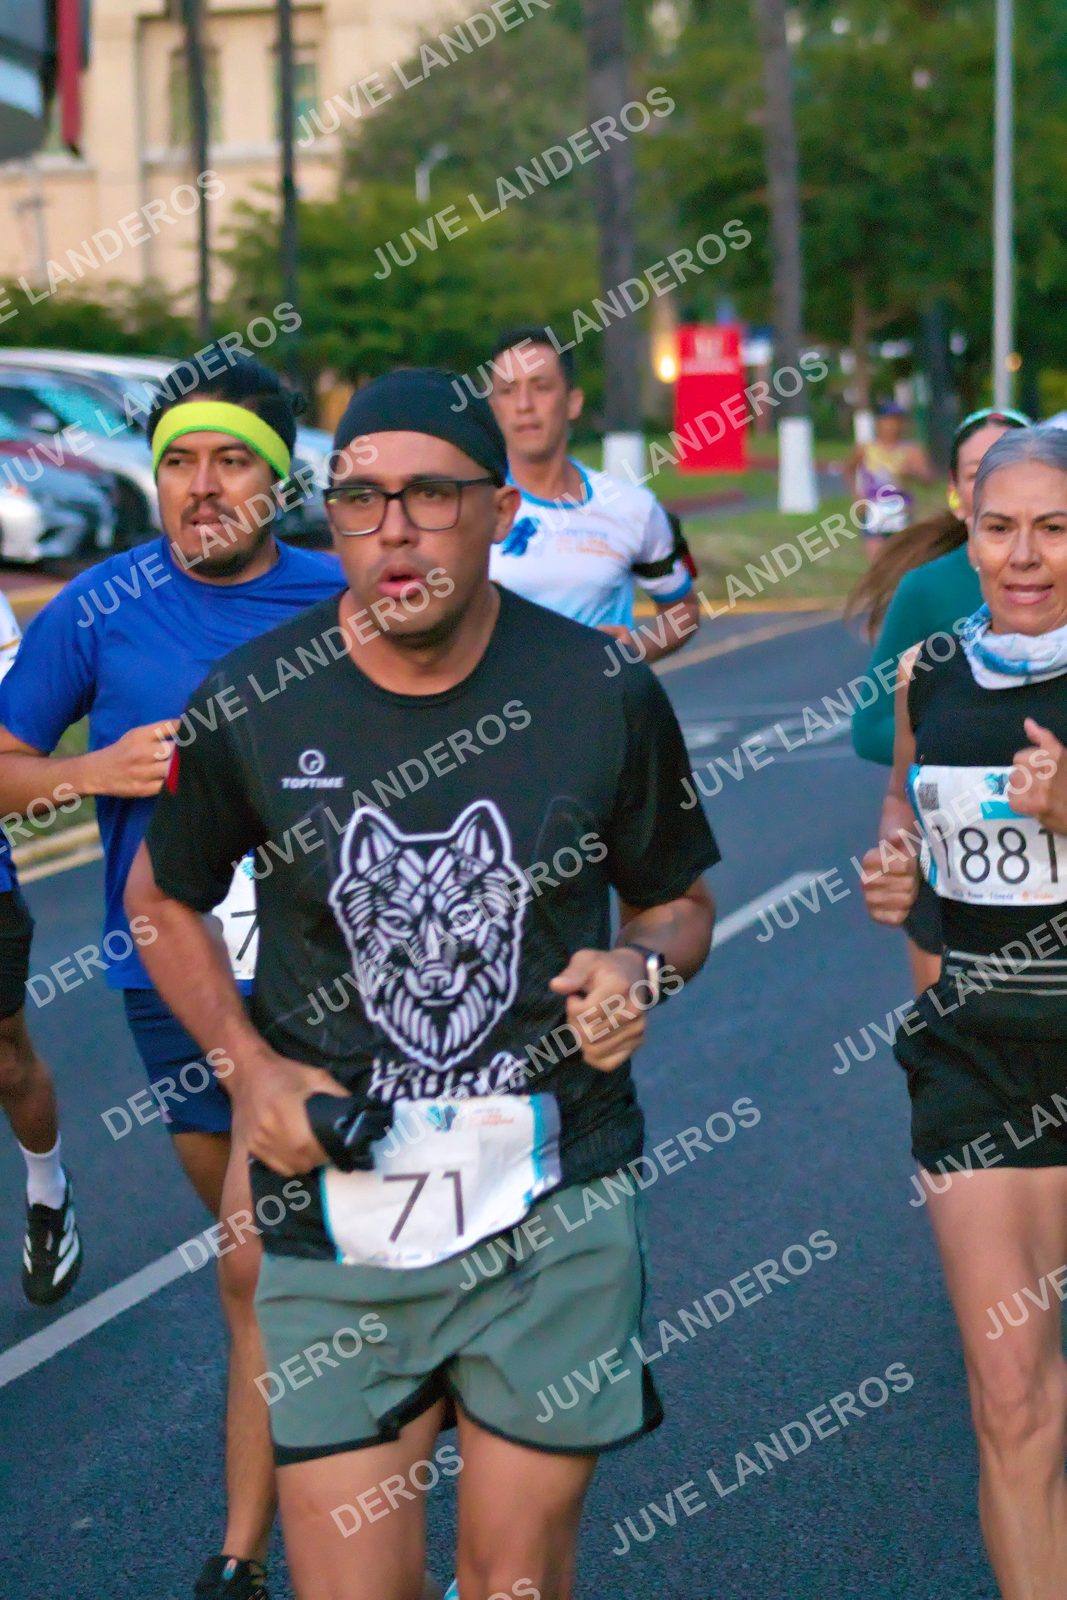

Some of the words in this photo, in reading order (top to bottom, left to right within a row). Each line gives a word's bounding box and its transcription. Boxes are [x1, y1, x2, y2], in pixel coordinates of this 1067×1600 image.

[281, 777, 344, 789] TOPTIME
[931, 825, 1059, 885] 1881
[383, 1169, 465, 1243] 71
